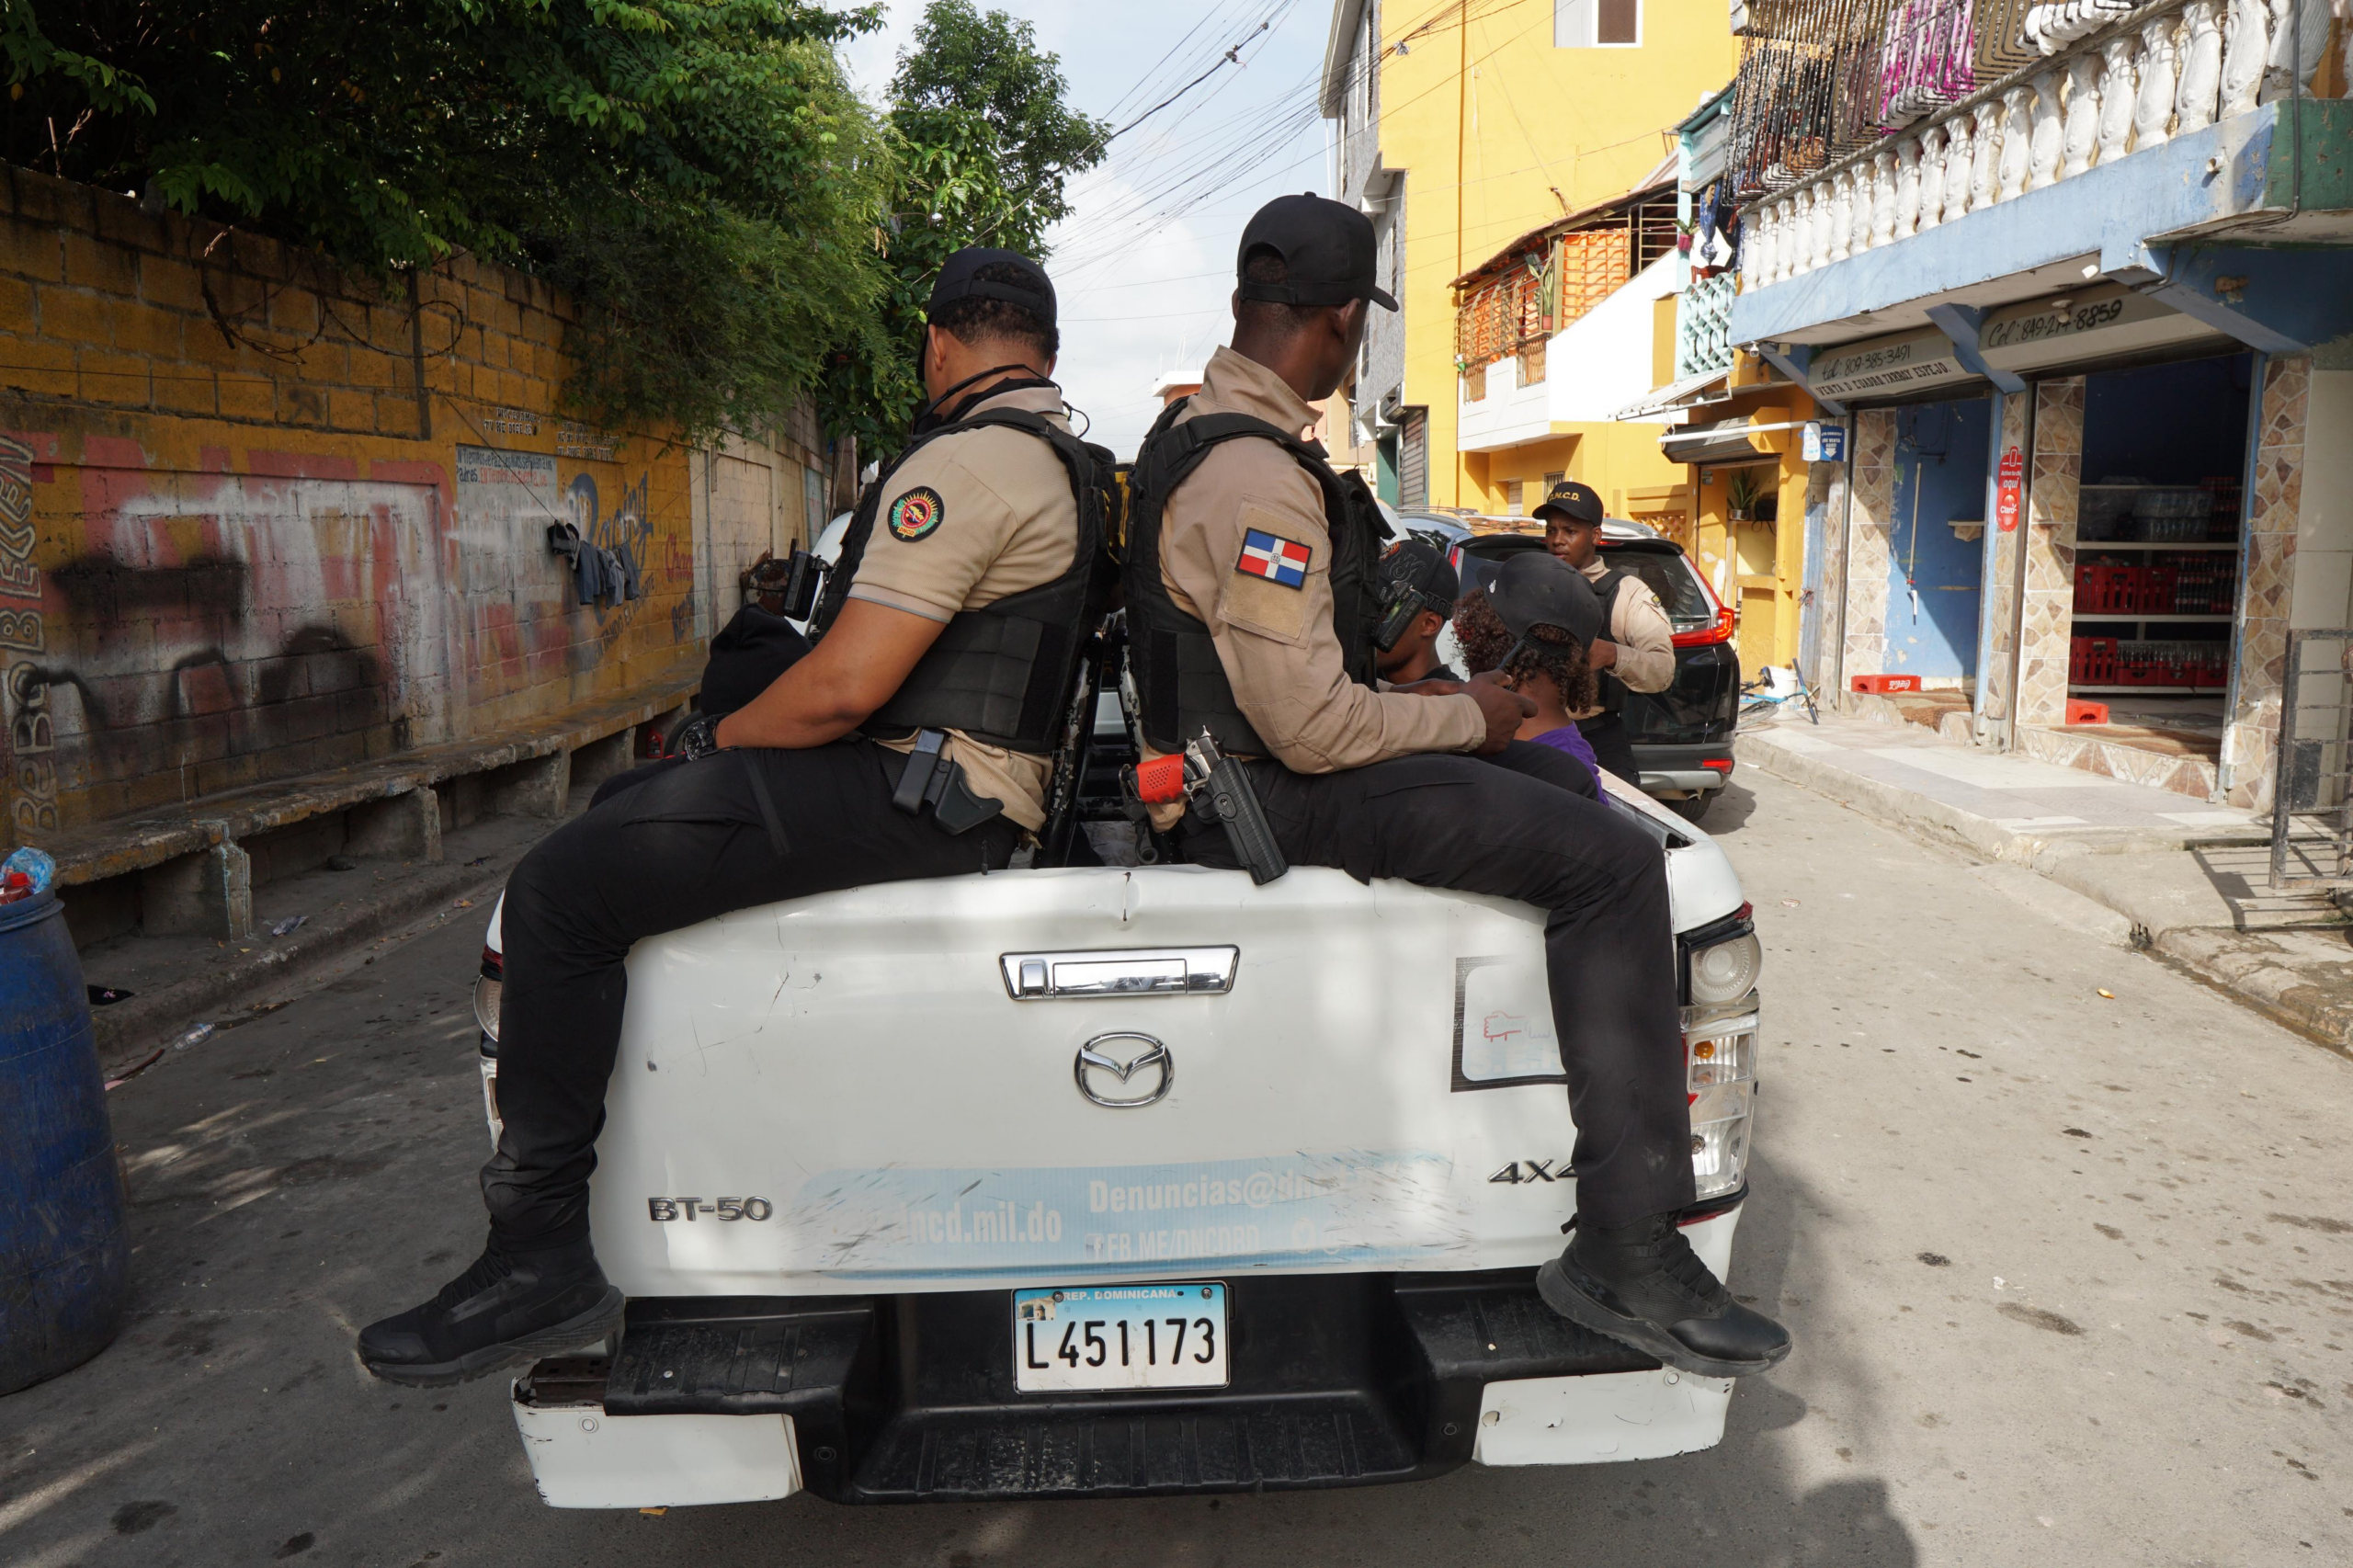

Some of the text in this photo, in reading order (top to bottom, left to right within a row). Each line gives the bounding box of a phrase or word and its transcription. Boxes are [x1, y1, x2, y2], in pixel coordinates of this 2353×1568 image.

[1815, 383, 1846, 396] VENTA
[2003, 476, 2020, 491] aquí
[2000, 504, 2016, 514] Claro
[648, 1196, 773, 1221] BT-50
[1063, 1289, 1177, 1301] REP. DOMINICANA
[1027, 1317, 1215, 1369] L451173
